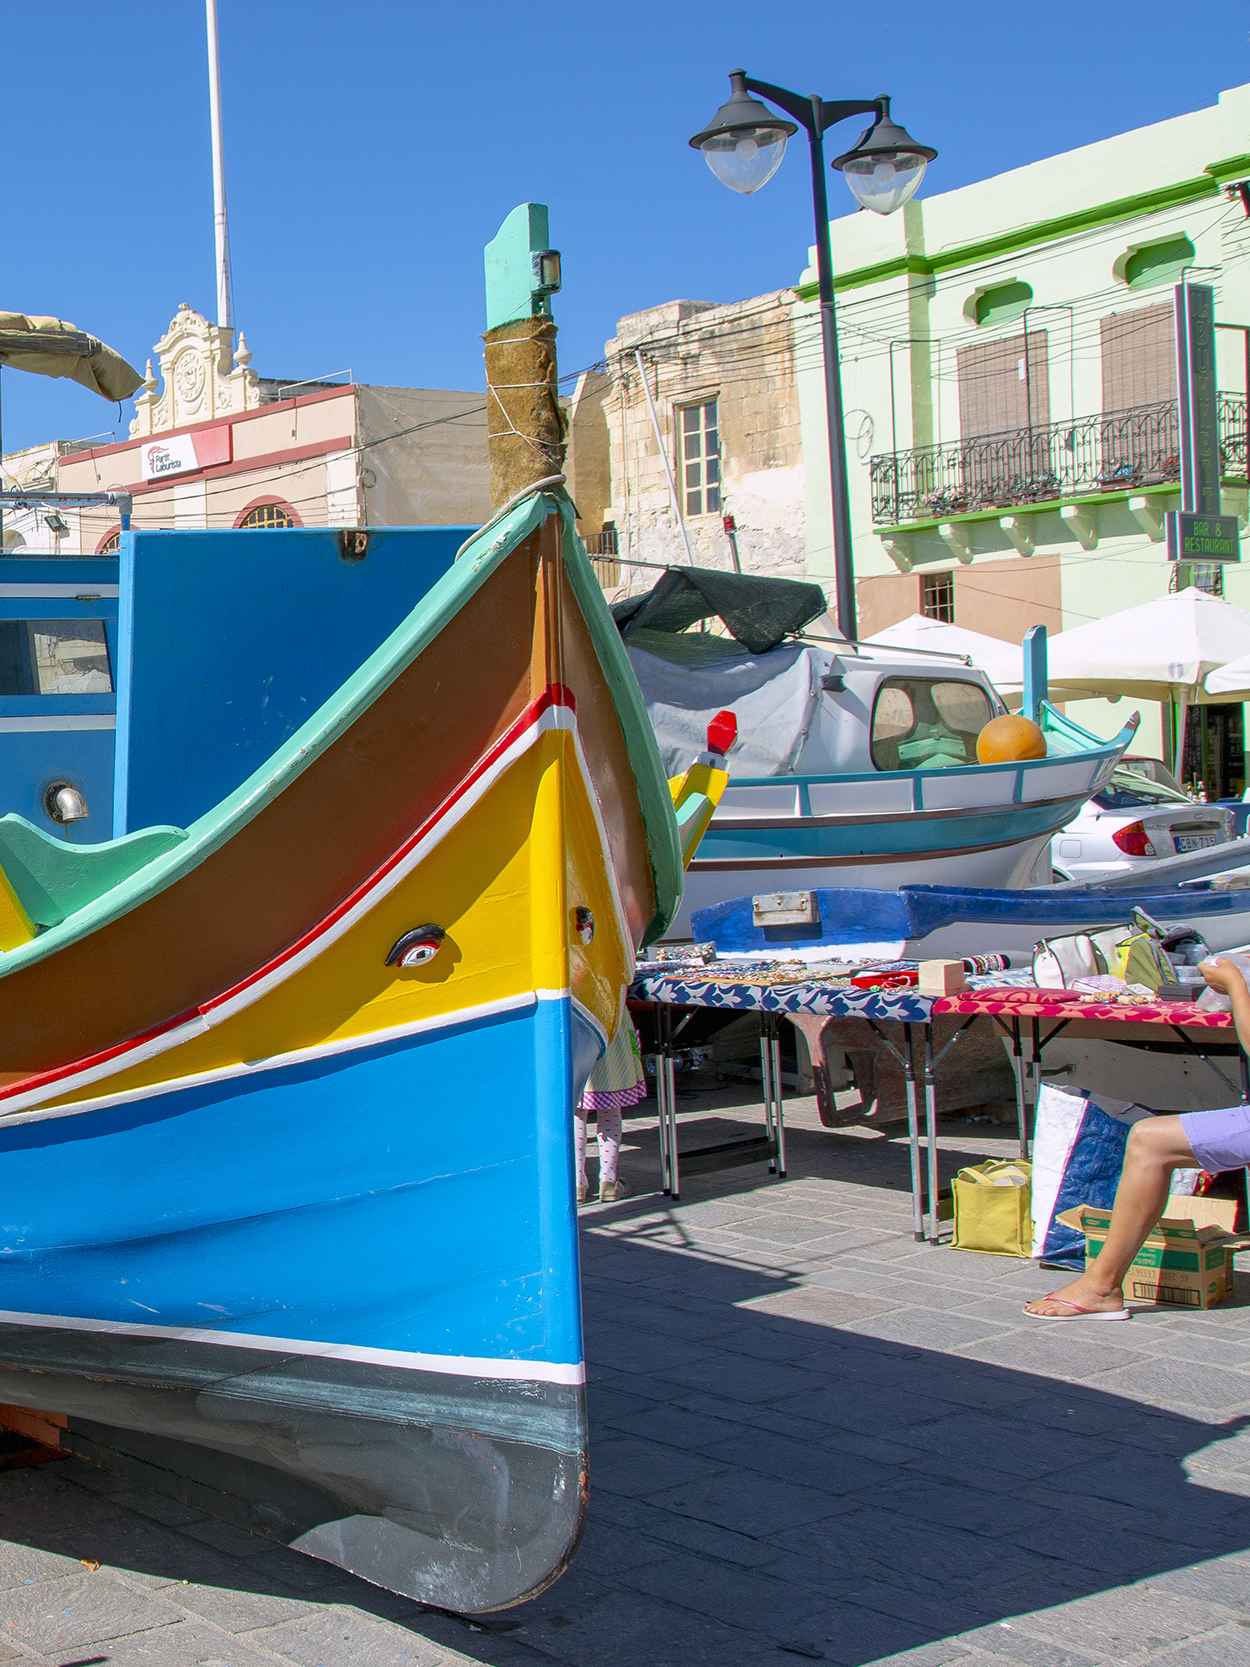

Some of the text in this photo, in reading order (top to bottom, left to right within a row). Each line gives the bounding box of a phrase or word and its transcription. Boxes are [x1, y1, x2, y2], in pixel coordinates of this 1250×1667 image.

[155, 452, 170, 463] Partit
[155, 459, 182, 473] Laburista
[1193, 520, 1222, 537] BAR &
[1184, 536, 1234, 554] RESTAURANT
[1180, 836, 1216, 850] CBN 715
